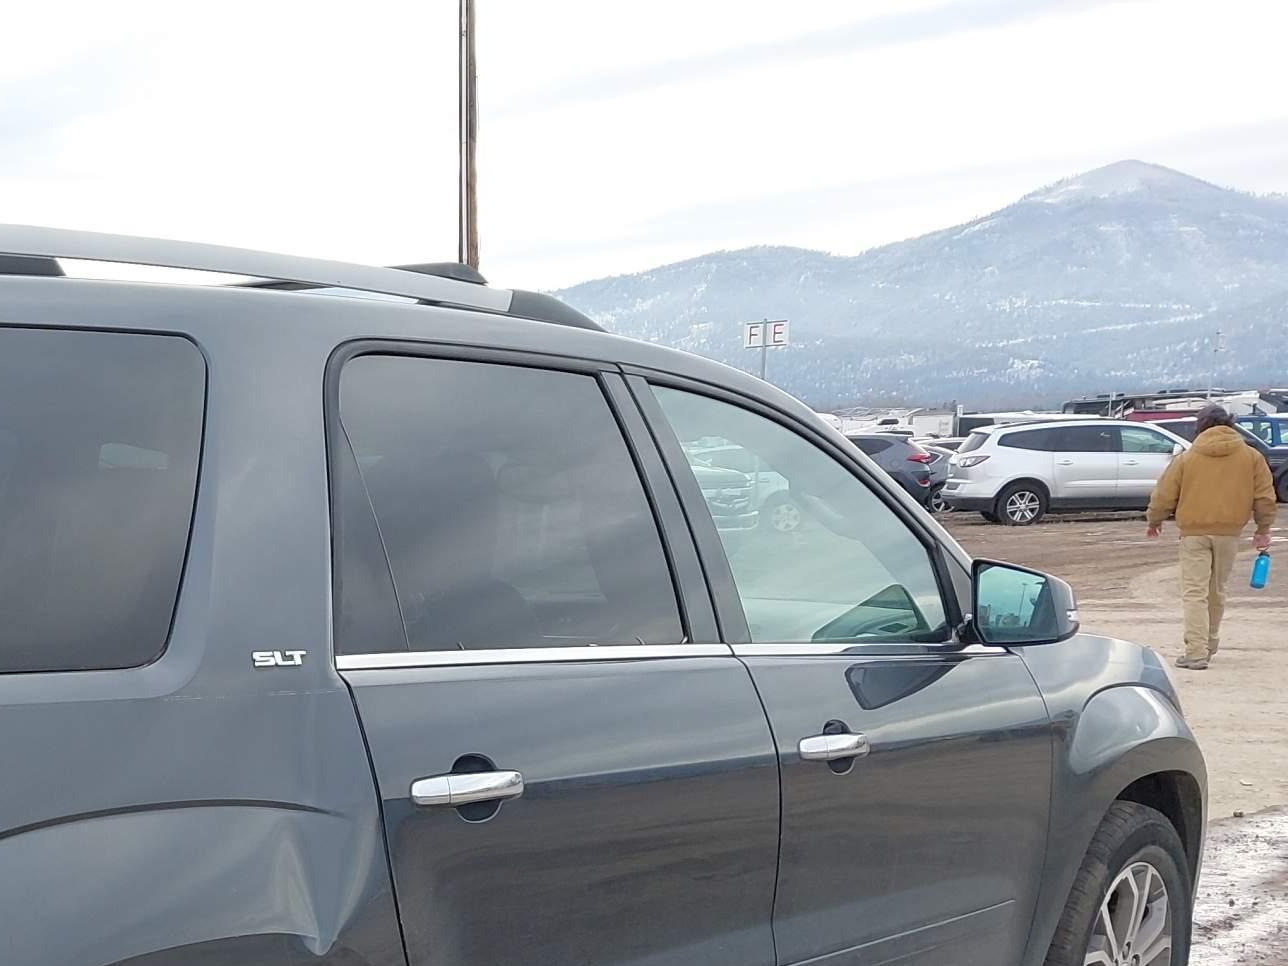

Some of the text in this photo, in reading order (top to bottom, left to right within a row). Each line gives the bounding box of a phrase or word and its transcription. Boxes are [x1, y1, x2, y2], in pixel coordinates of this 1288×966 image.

[749, 323, 785, 345] F E
[251, 650, 307, 668] SLT
